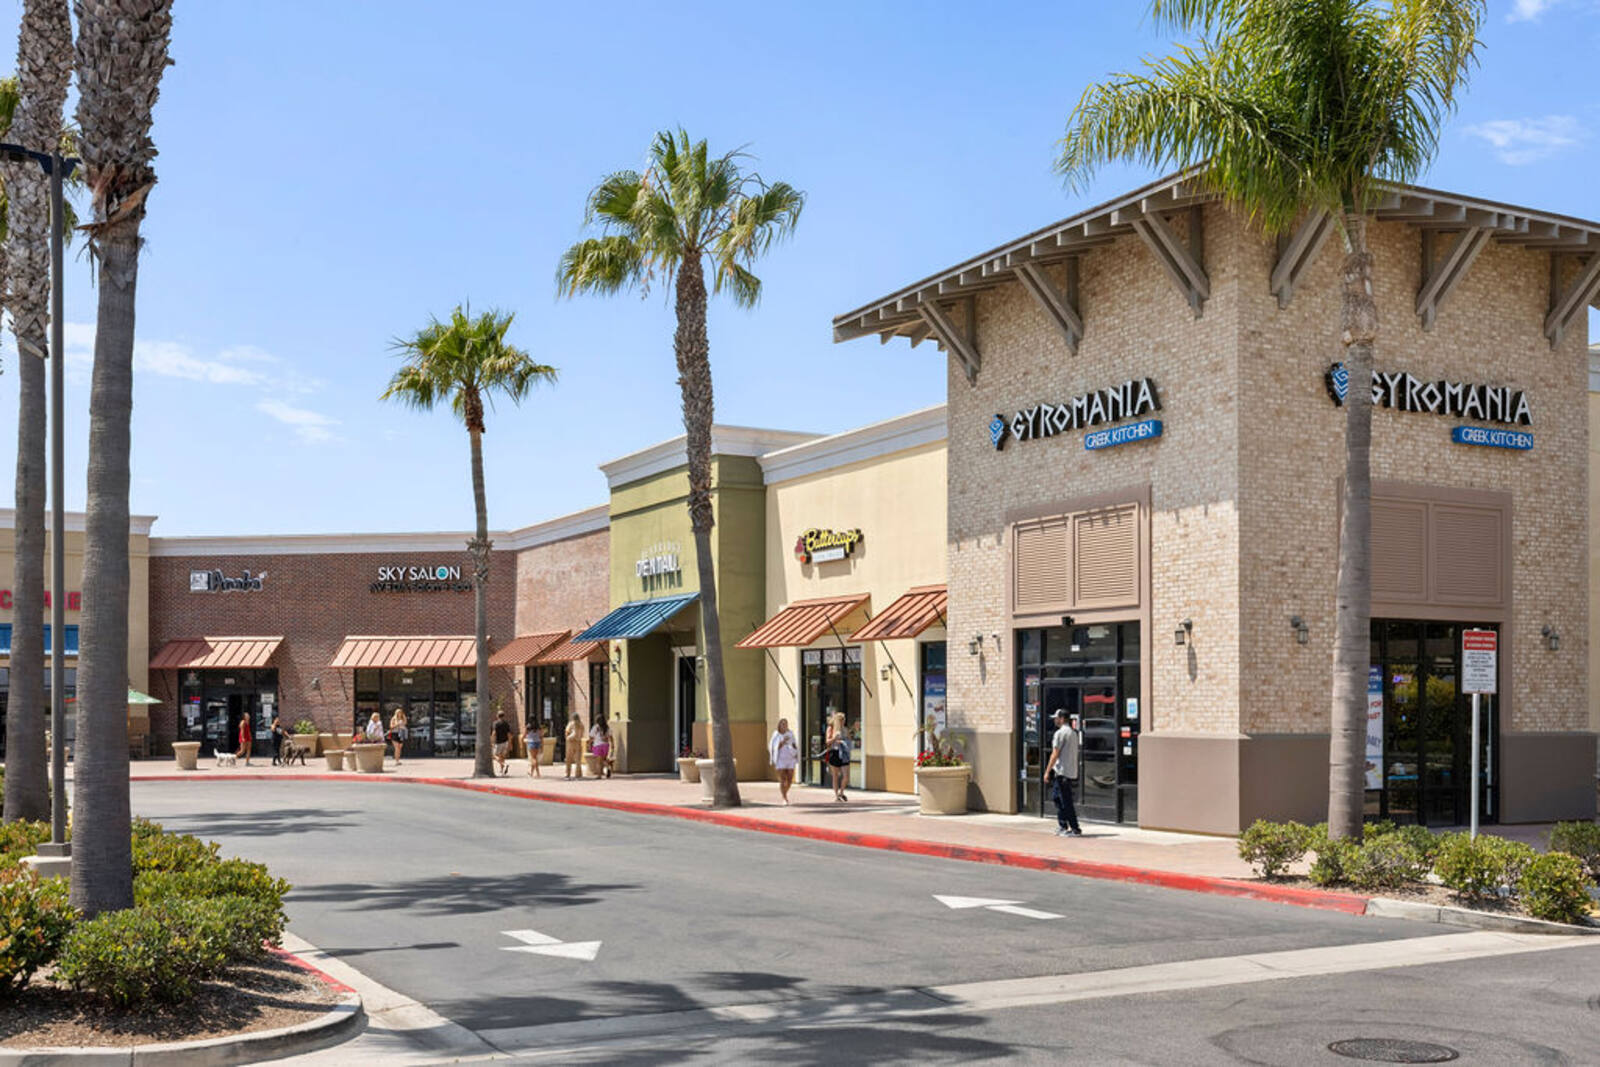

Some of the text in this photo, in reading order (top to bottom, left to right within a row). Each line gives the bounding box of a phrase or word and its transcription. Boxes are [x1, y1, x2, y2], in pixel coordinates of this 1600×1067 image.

[1010, 378, 1156, 441] GYROMANIA
[1087, 422, 1153, 448] GREEK KITCHEN
[1461, 428, 1533, 448] GREEK KITCHEN
[378, 565, 461, 581] SKY SALON
[636, 554, 680, 577] DENTAL
